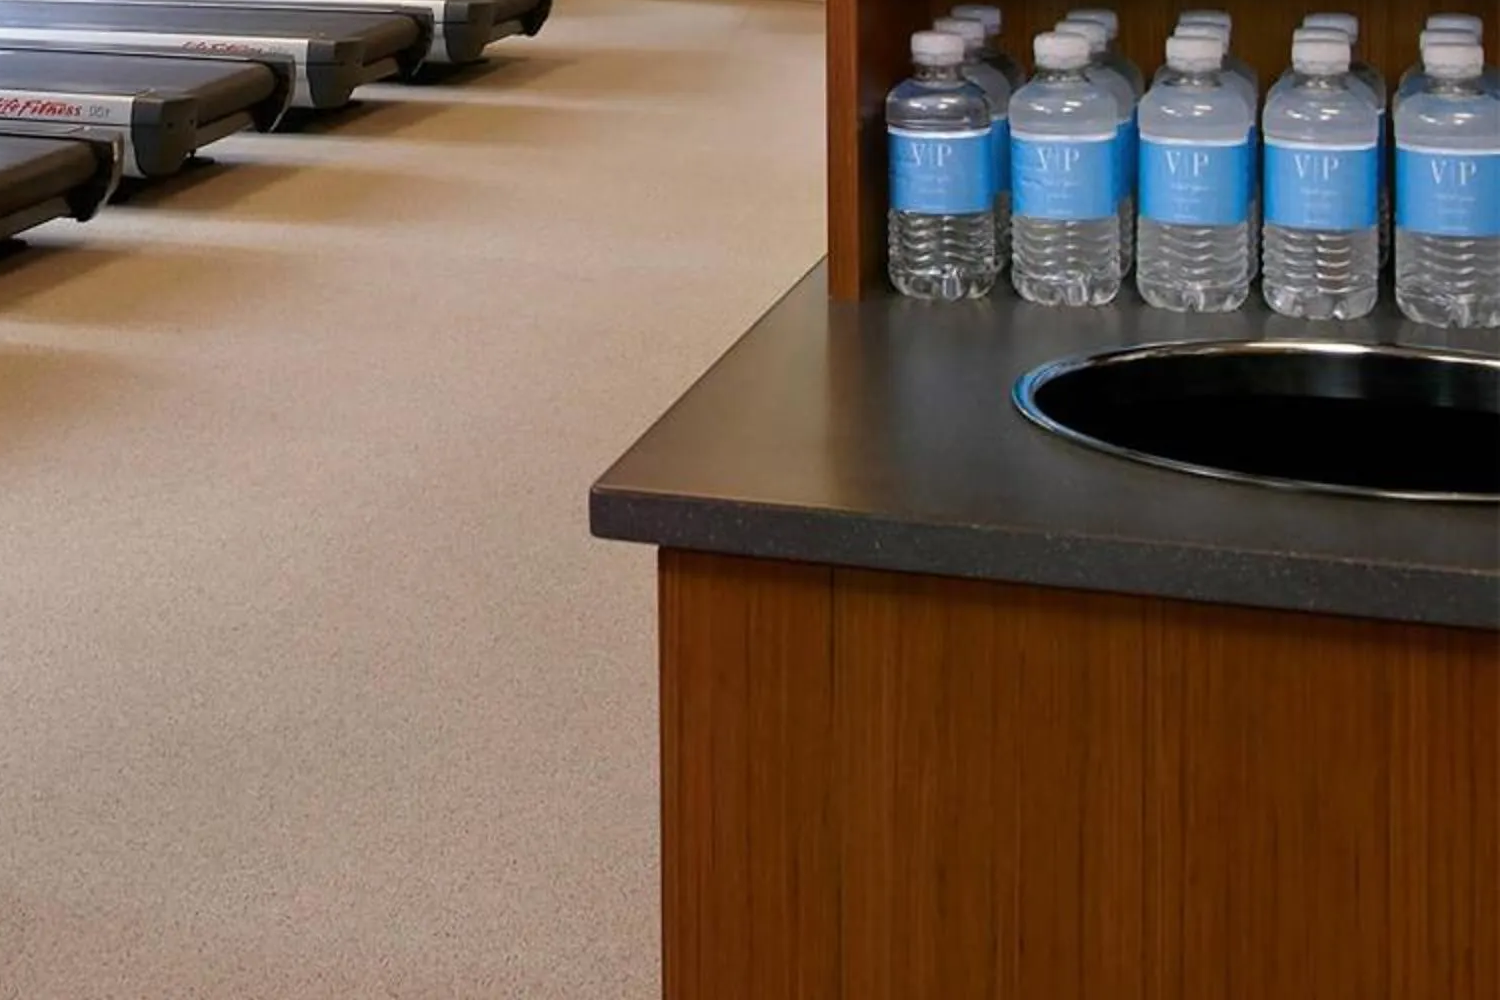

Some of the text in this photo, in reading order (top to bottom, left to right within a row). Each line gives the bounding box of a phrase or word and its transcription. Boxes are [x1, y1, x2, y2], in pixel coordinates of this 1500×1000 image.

[911, 142, 952, 167] VIP
[1036, 147, 1080, 172] VIP
[1164, 150, 1210, 177] VIP
[1293, 154, 1339, 181] VIP
[1431, 159, 1477, 186] VIP
